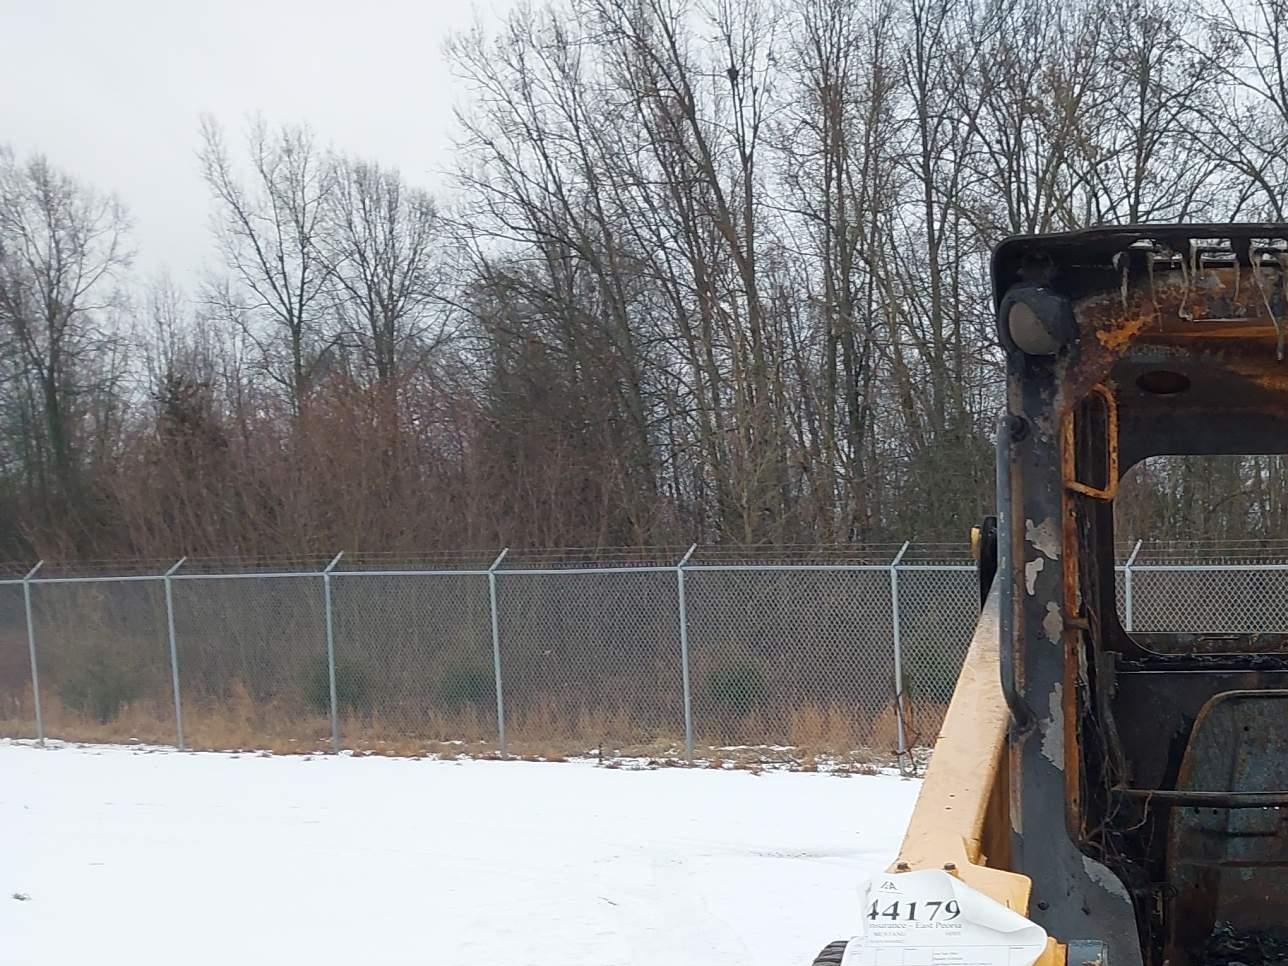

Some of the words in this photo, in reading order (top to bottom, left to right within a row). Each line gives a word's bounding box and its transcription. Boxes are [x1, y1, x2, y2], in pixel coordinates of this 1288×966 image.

[866, 899, 961, 921] 44179
[915, 921, 933, 929] East
[936, 921, 963, 929] Peoria
